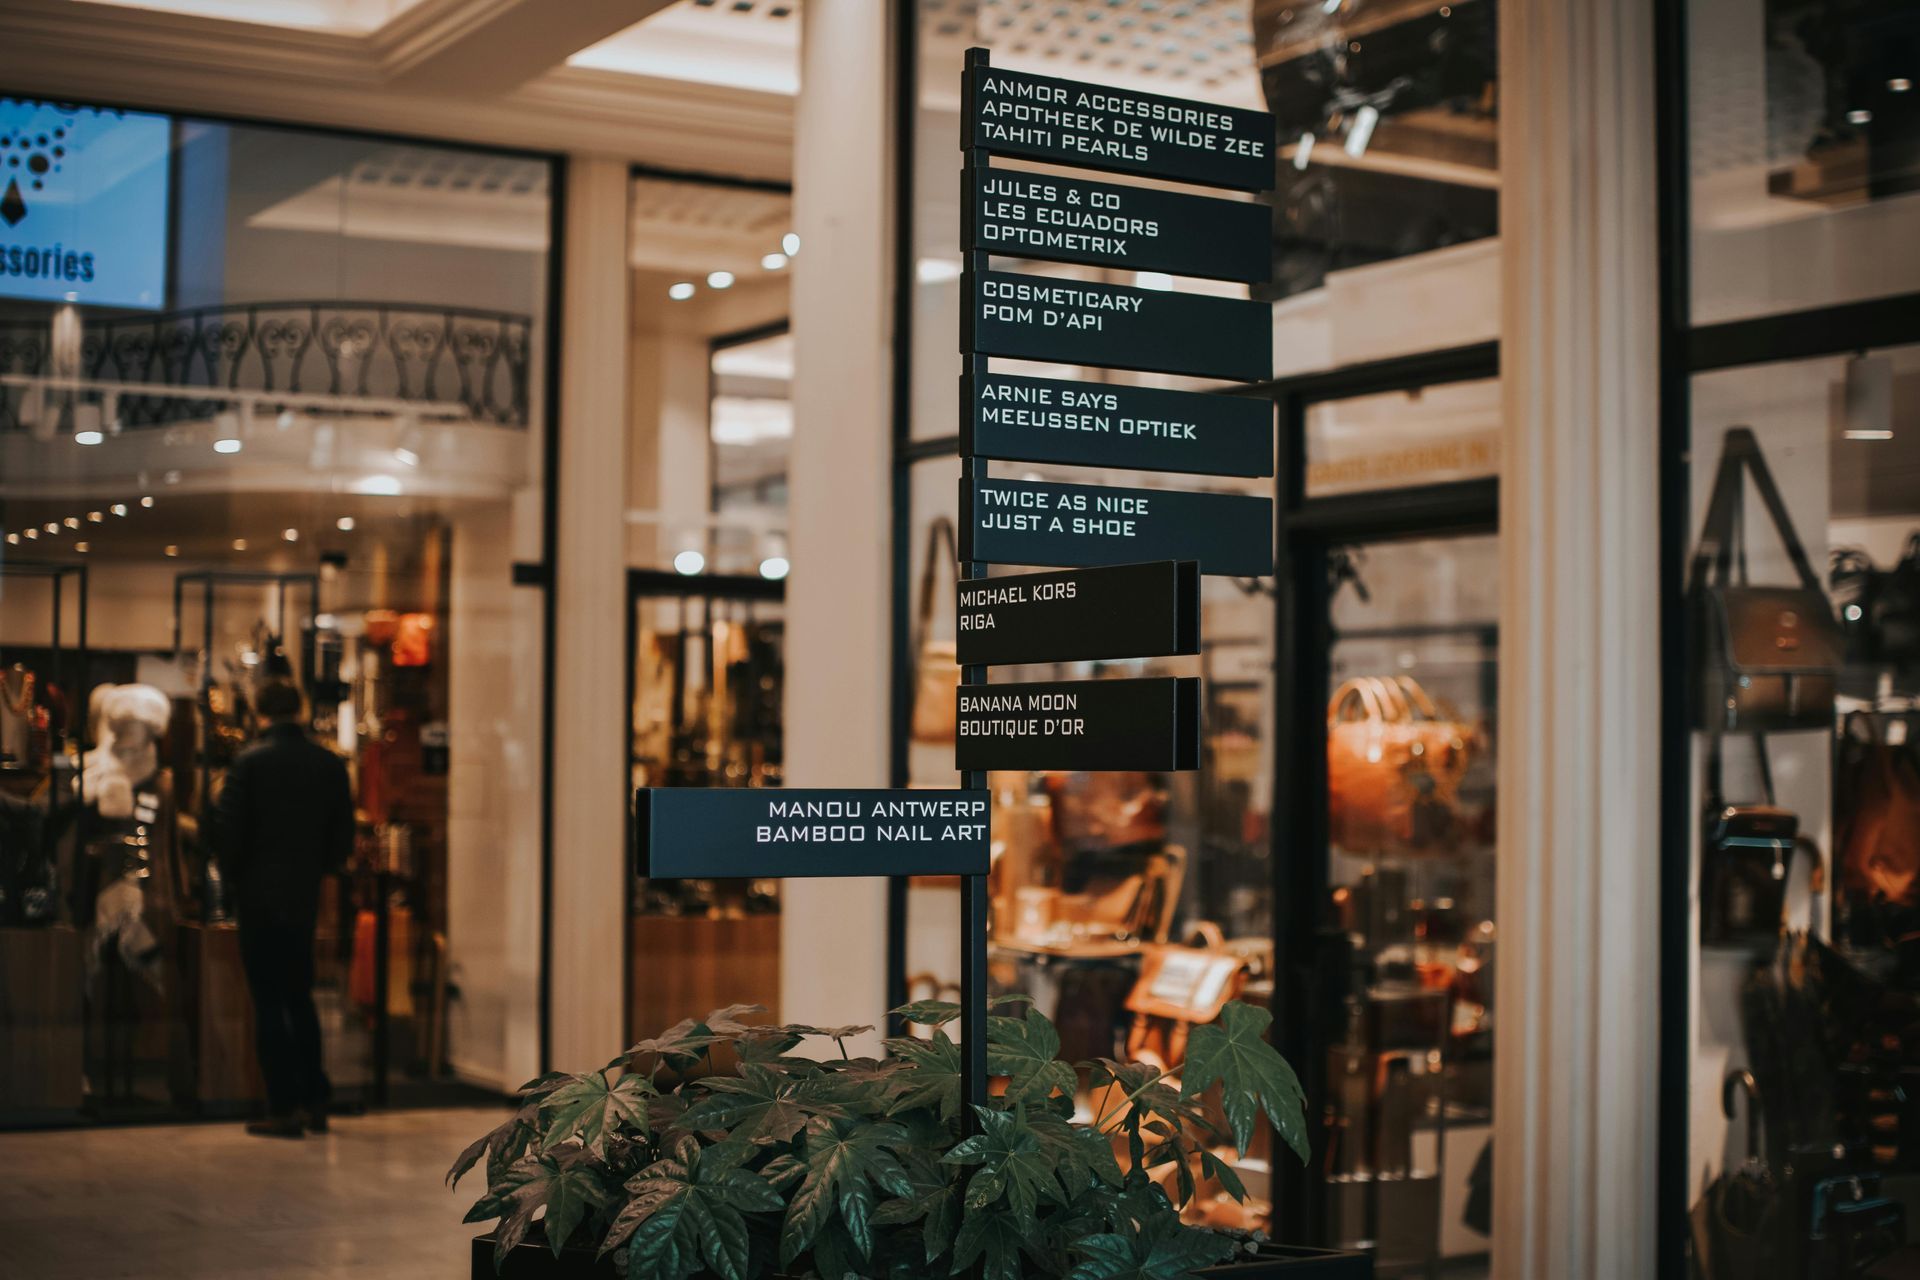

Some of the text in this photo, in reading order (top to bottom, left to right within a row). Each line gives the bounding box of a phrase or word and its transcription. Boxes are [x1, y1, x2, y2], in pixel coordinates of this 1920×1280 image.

[982, 77, 1233, 131] ANMOR ACCESSORIES
[980, 121, 1148, 162] TAHITI PEARLS
[982, 100, 1264, 158] APOTHEEK DE WILDE ZEE
[983, 178, 1120, 210] JULES & CO
[983, 200, 1159, 237] LES ECUADORS
[983, 223, 1127, 256] OPTOMETRIX
[983, 280, 1143, 313] COSMETICARY
[983, 303, 1102, 331] POM D'API
[980, 383, 1118, 411] ARNIE SAYS
[982, 406, 1197, 440] MEEUSSEN OPTIEK
[979, 488, 1149, 515] TWICE AS NICE
[981, 512, 1136, 537] JUST A SHOE
[960, 581, 1076, 608] MICHAEL KORS
[960, 613, 996, 631] RIGA
[960, 694, 1077, 713] BANANA MOON
[960, 718, 1084, 739] BOUTIQUE D'OR
[769, 801, 986, 818] MANOU ANTWERP
[756, 824, 987, 843] BAMBOO NAIL ART
